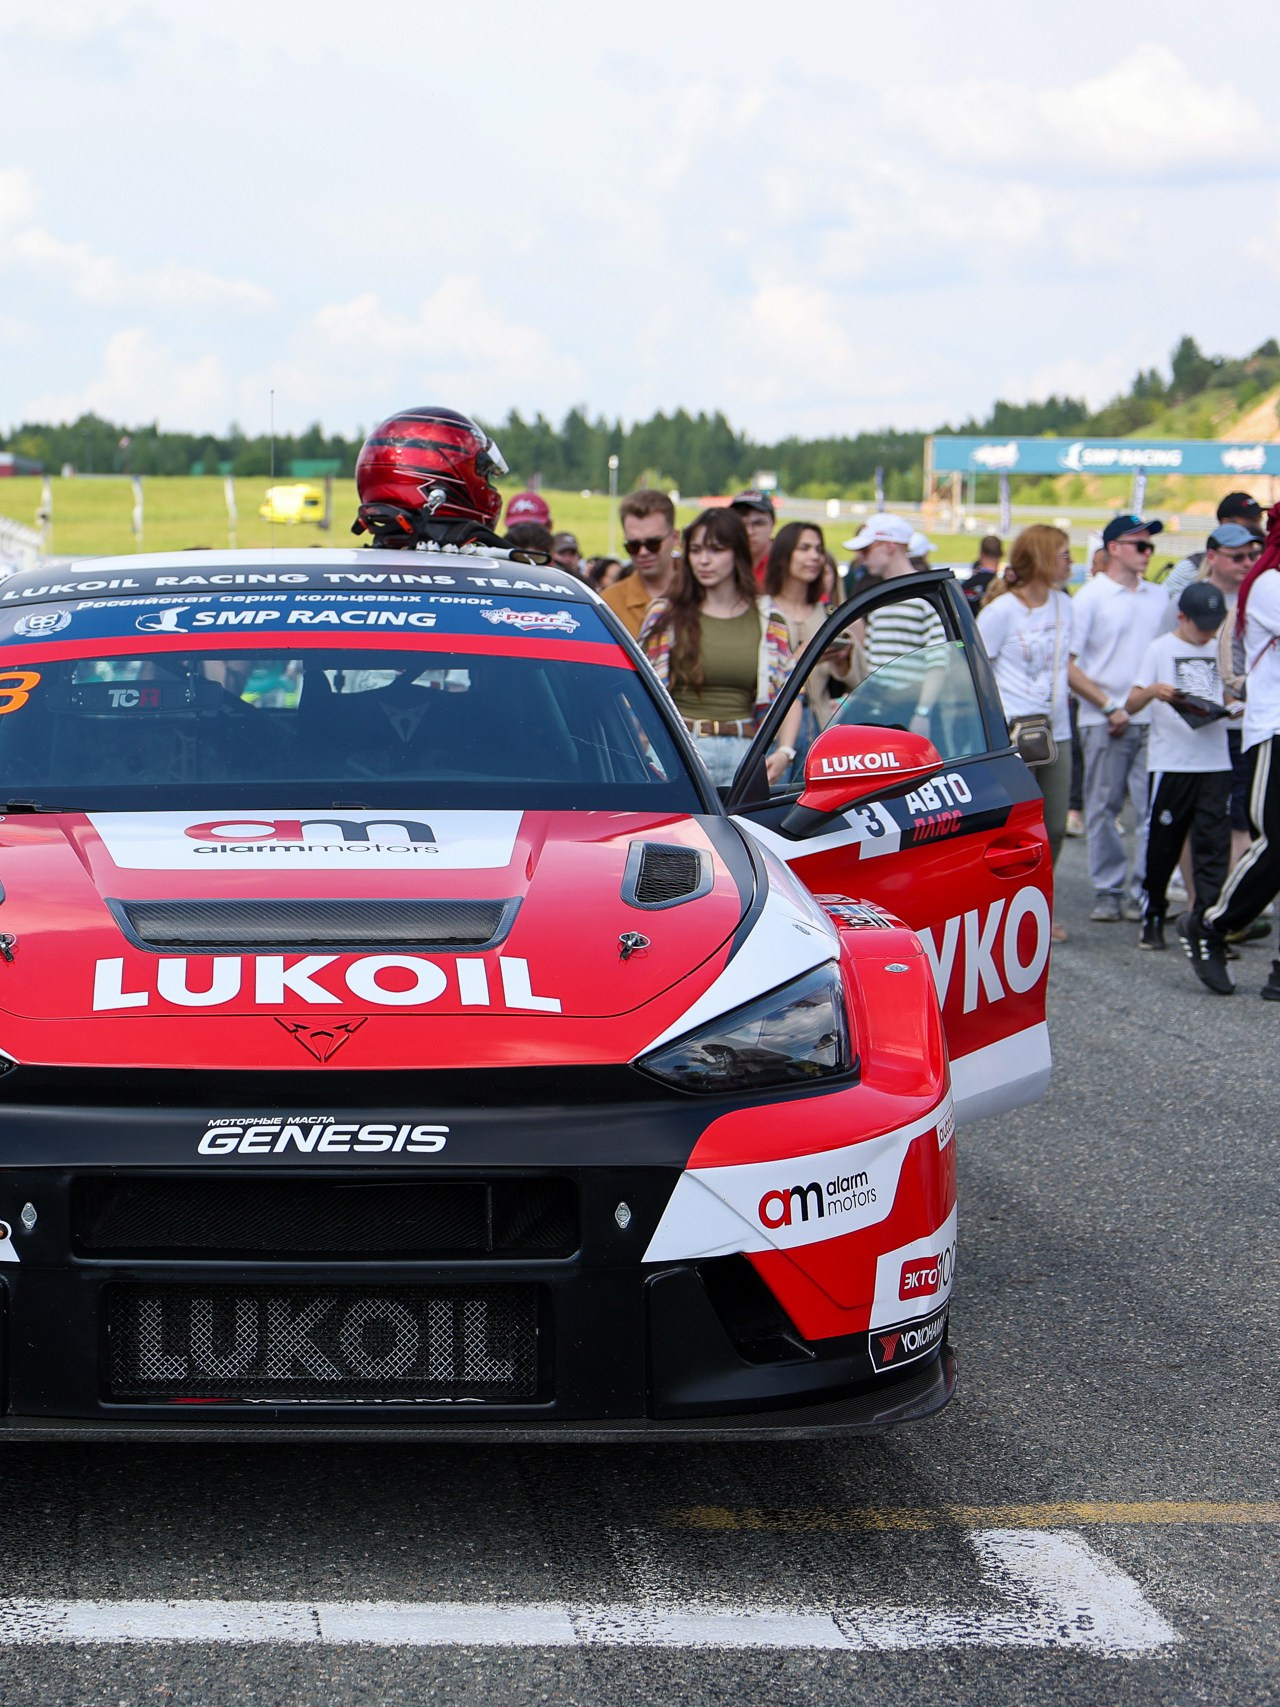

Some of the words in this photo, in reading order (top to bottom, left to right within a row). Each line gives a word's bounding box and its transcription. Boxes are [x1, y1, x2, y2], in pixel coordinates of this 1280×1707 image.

[2, 578, 139, 600] LUKOIL
[155, 573, 310, 587] RACING
[323, 573, 456, 586] TWINS
[467, 576, 575, 596] TEAM
[76, 595, 212, 611] Российская
[219, 594, 288, 605] серия
[295, 594, 421, 604] кольцевых
[429, 595, 493, 606] гонок
[192, 610, 281, 627] SMP
[287, 609, 437, 628] RACING
[108, 688, 160, 708] TCR
[821, 752, 900, 774] LUKOIL
[904, 772, 972, 815] АВТО
[857, 803, 886, 838] 3
[912, 809, 964, 841] ПЛЮС
[92, 955, 562, 1013] LUKOIL
[208, 1117, 282, 1127] МОТОРНЫЕ
[287, 1116, 335, 1125] МАСЛА
[197, 1124, 450, 1155] GENESIS
[826, 1171, 869, 1196] alarm
[758, 1181, 824, 1229] am
[827, 1187, 877, 1216] motors
[139, 1298, 514, 1381] LUKOIL
